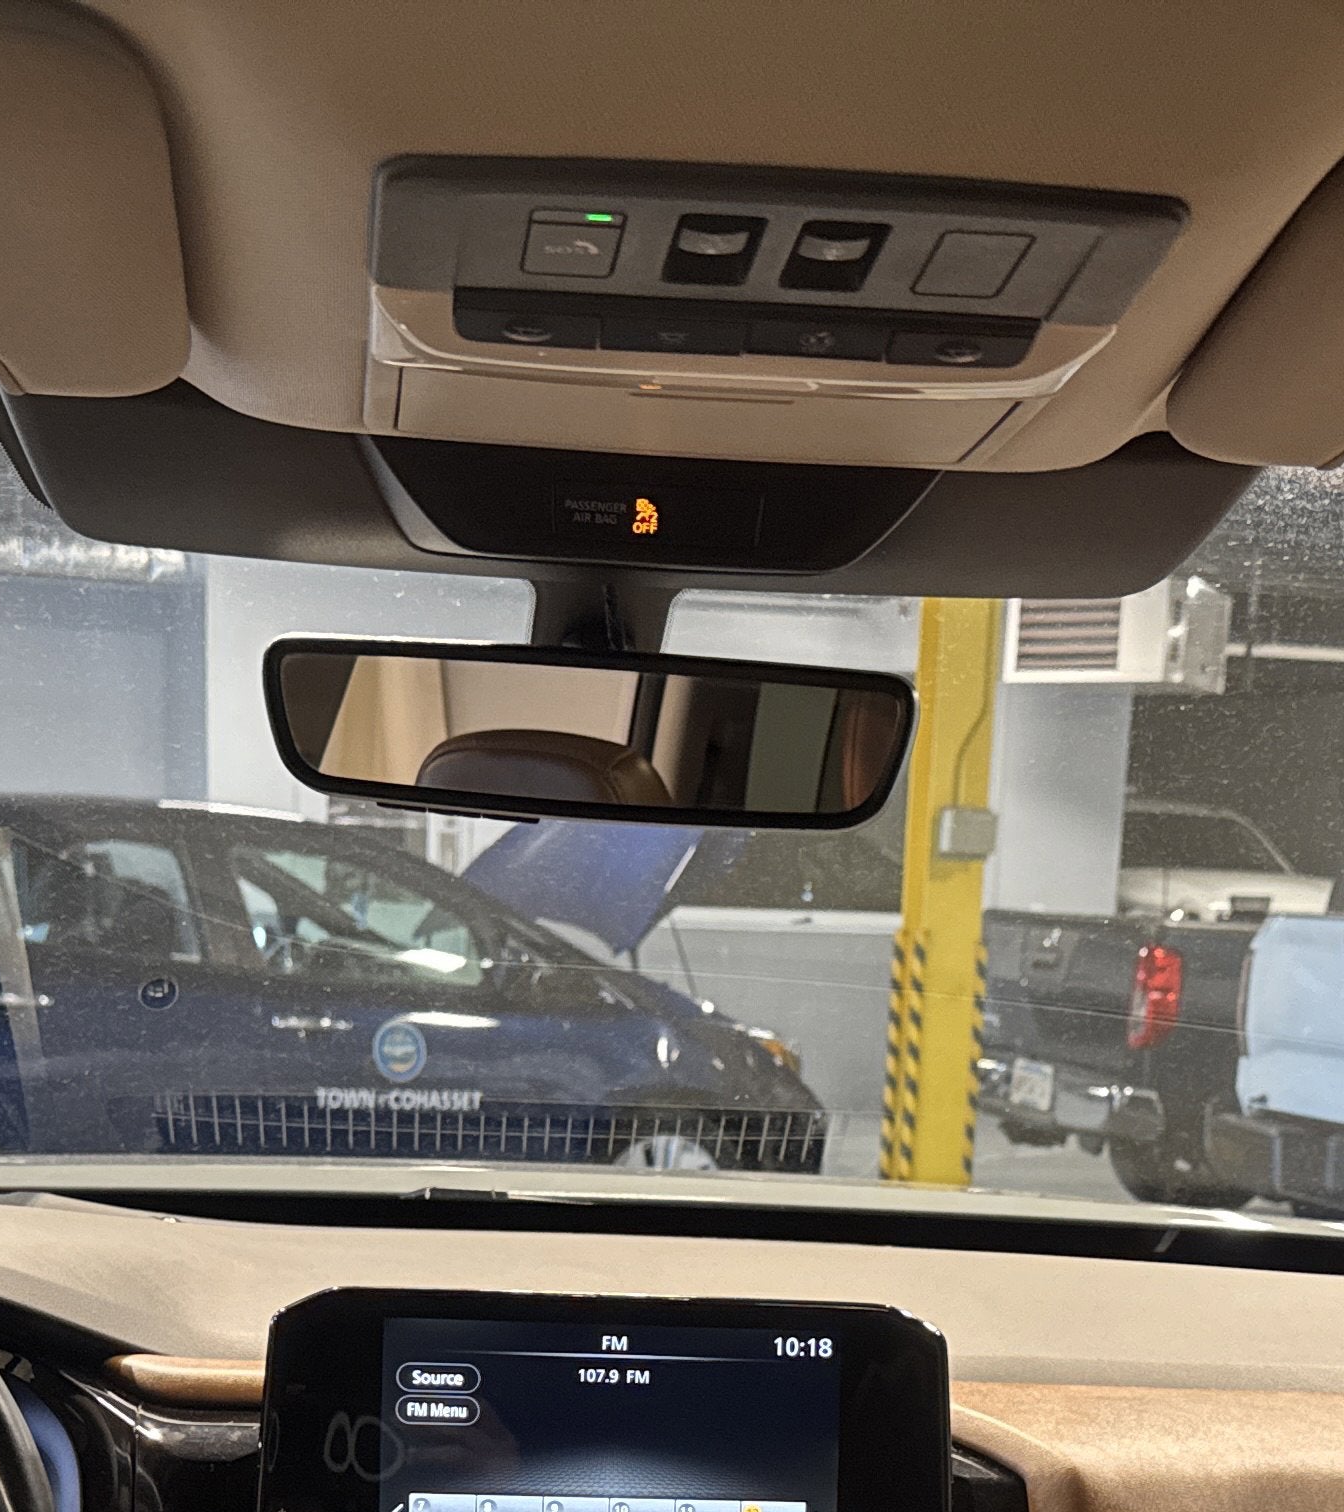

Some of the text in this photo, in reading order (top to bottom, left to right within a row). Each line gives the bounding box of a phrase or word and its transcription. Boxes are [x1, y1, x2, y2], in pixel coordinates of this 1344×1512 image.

[564, 499, 627, 513] PASSENGER
[573, 511, 618, 525] AIR BAG
[632, 521, 658, 534] OFF
[315, 1085, 377, 1110] TOWN
[387, 1087, 483, 1112] COHASSET
[601, 1335, 629, 1351] FM
[773, 1336, 833, 1358] 10:18
[411, 1368, 465, 1386] Source
[577, 1368, 651, 1385] 107.9 FM
[406, 1401, 468, 1419] FM Menu
[417, 1501, 426, 1512] 7
[482, 1502, 492, 1512] 8
